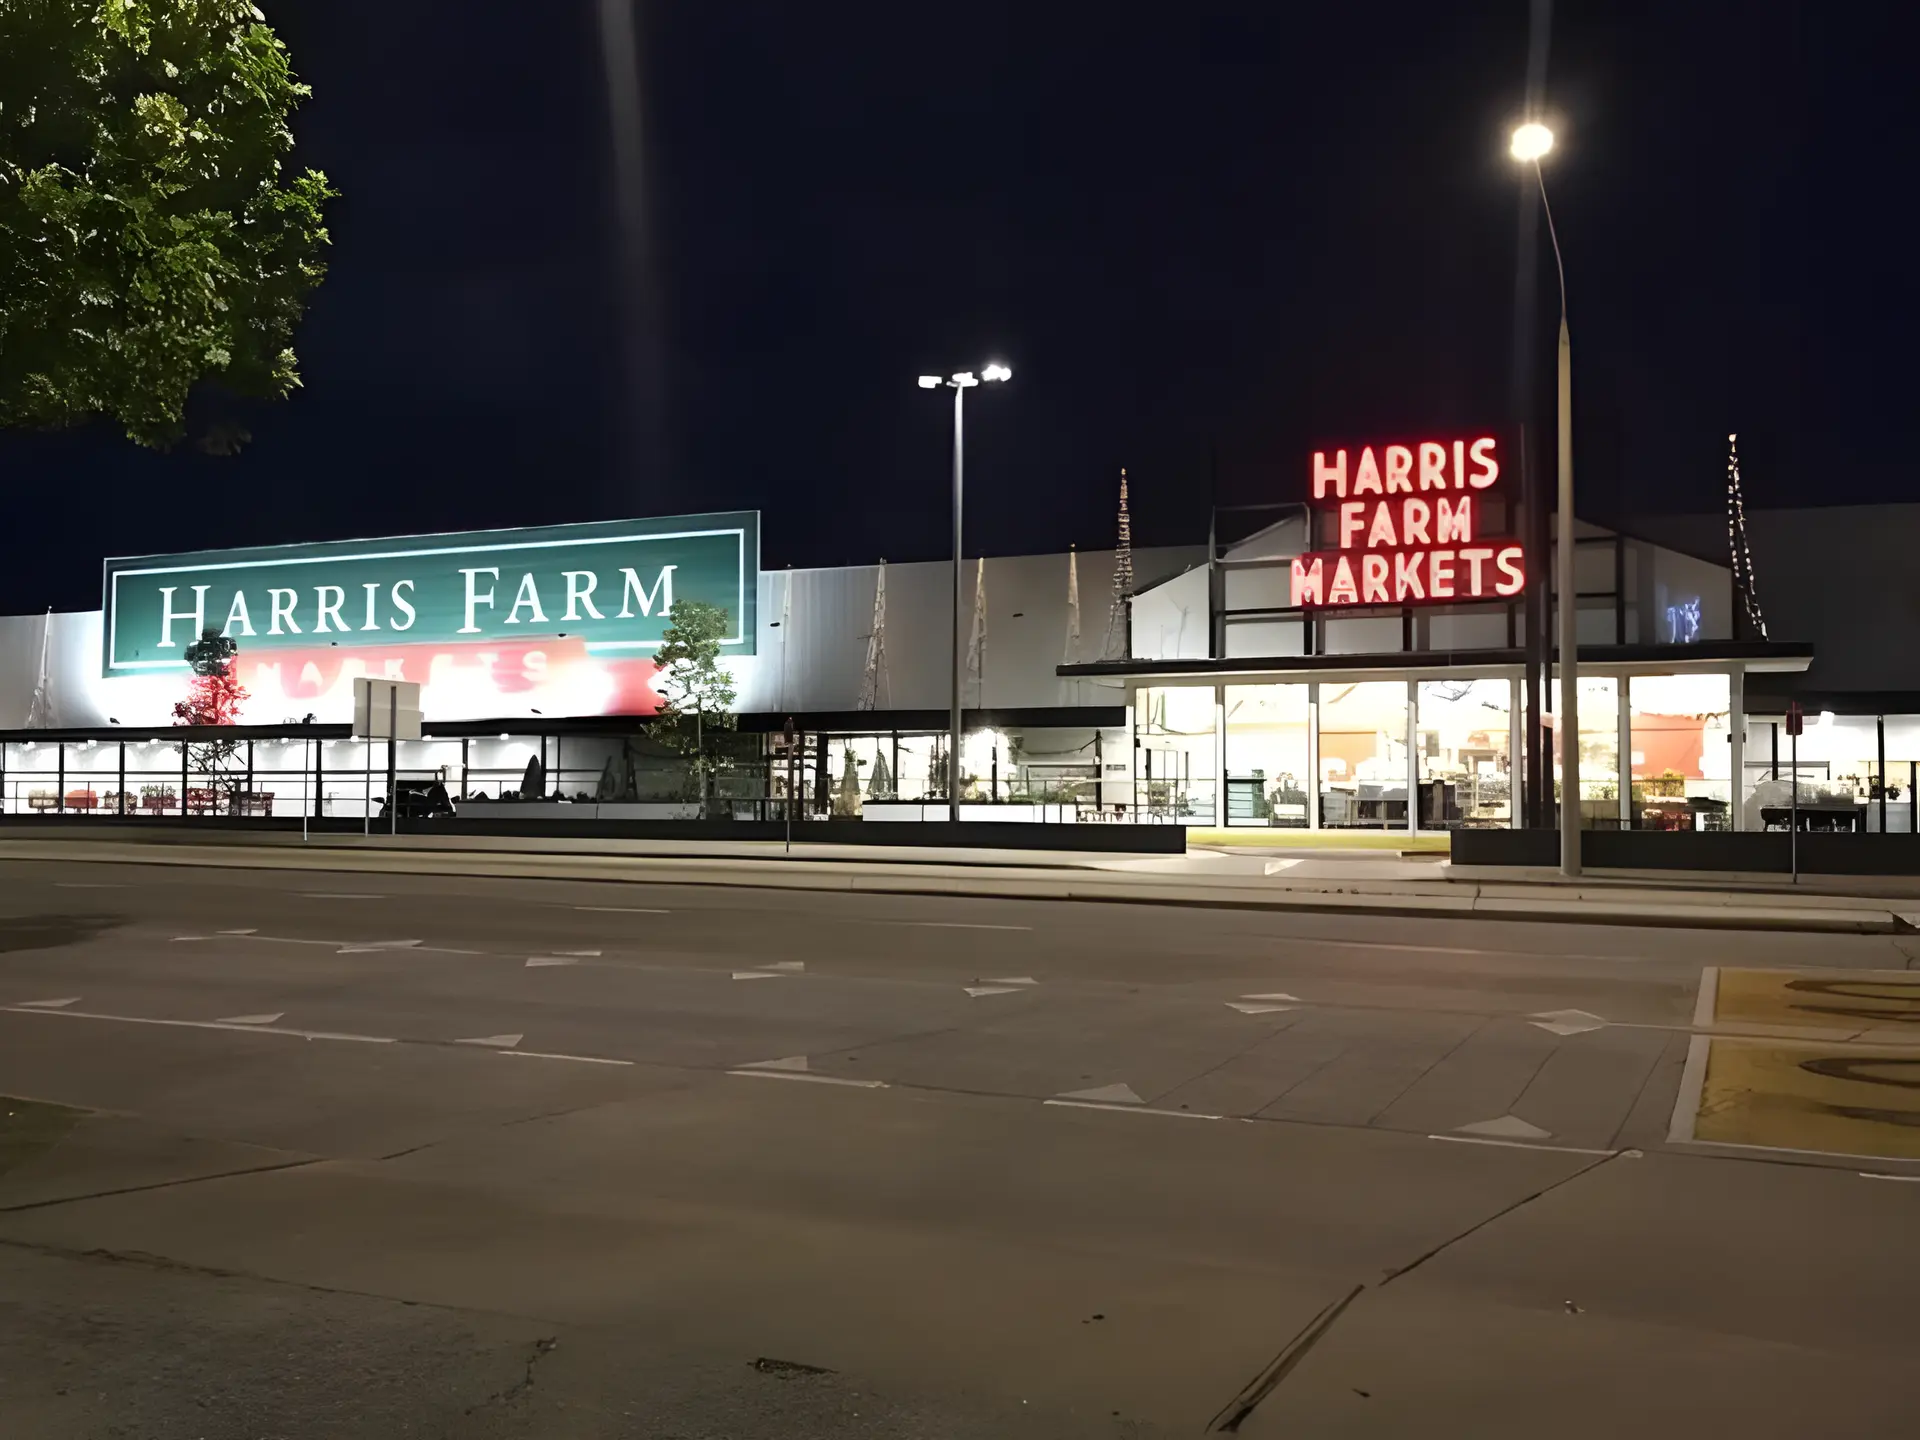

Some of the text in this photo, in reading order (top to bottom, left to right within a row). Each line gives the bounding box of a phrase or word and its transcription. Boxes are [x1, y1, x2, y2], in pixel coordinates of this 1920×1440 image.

[1313, 438, 1499, 498] HARRIS
[1340, 496, 1471, 548] FARM
[157, 565, 678, 647] HARRIS FARM
[1291, 547, 1525, 606] MARKETS
[256, 650, 548, 695] MAKTS
